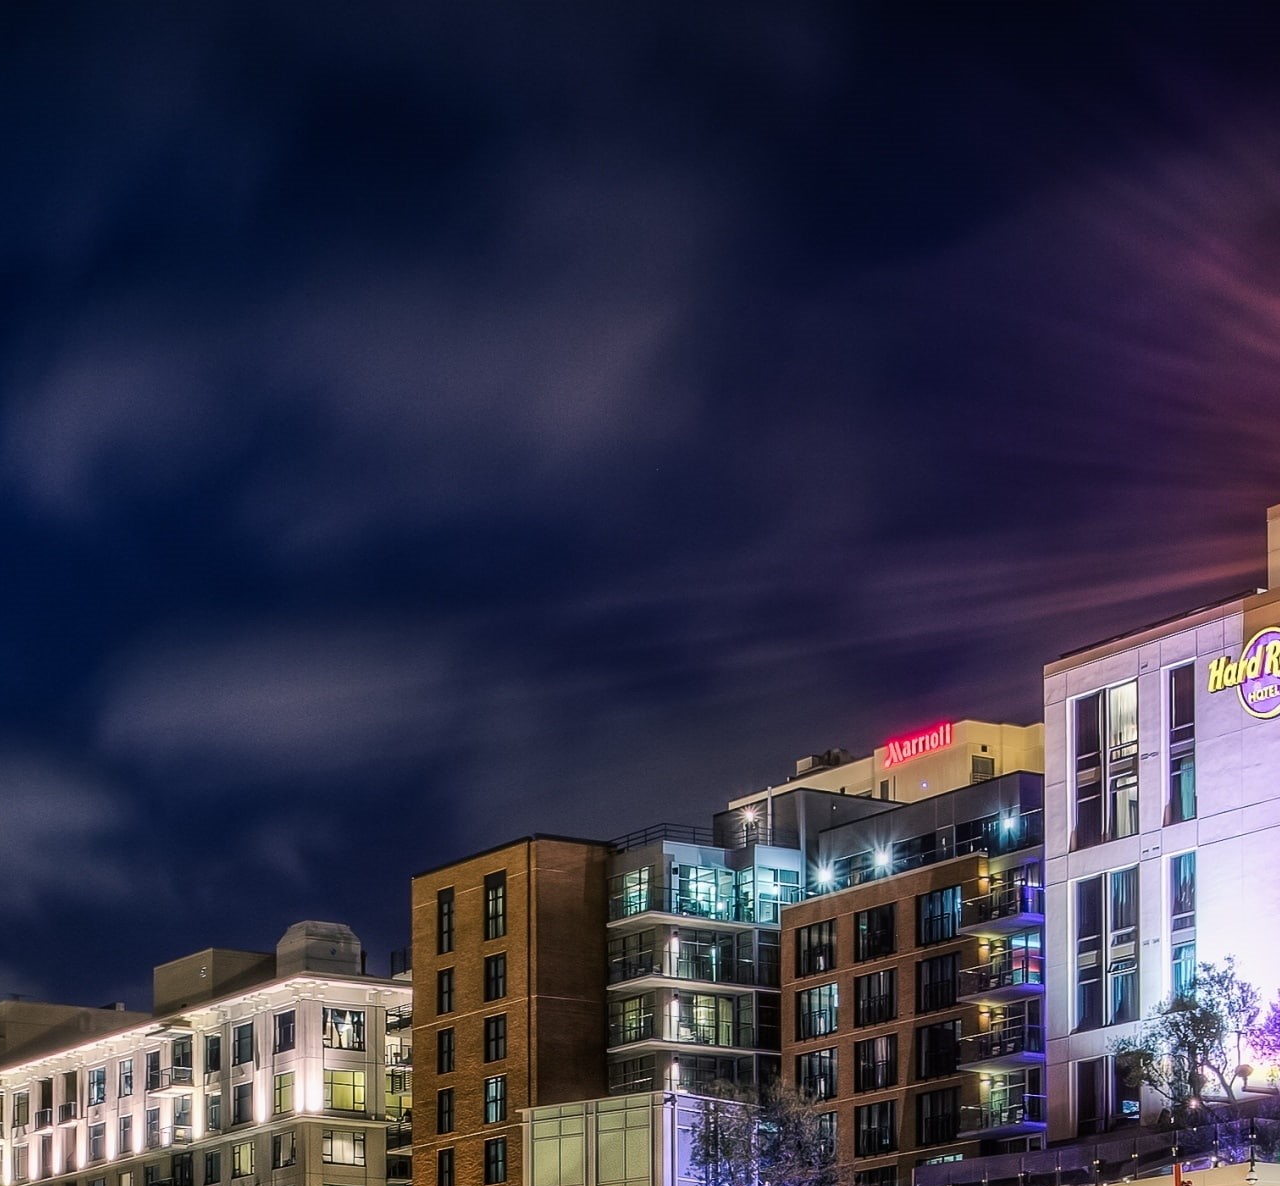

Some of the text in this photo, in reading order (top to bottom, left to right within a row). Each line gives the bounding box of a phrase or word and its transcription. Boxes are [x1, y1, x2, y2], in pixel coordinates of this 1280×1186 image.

[1208, 645, 1264, 693] Hard
[1248, 684, 1280, 703] HOTEL
[884, 723, 952, 768] Marriott
